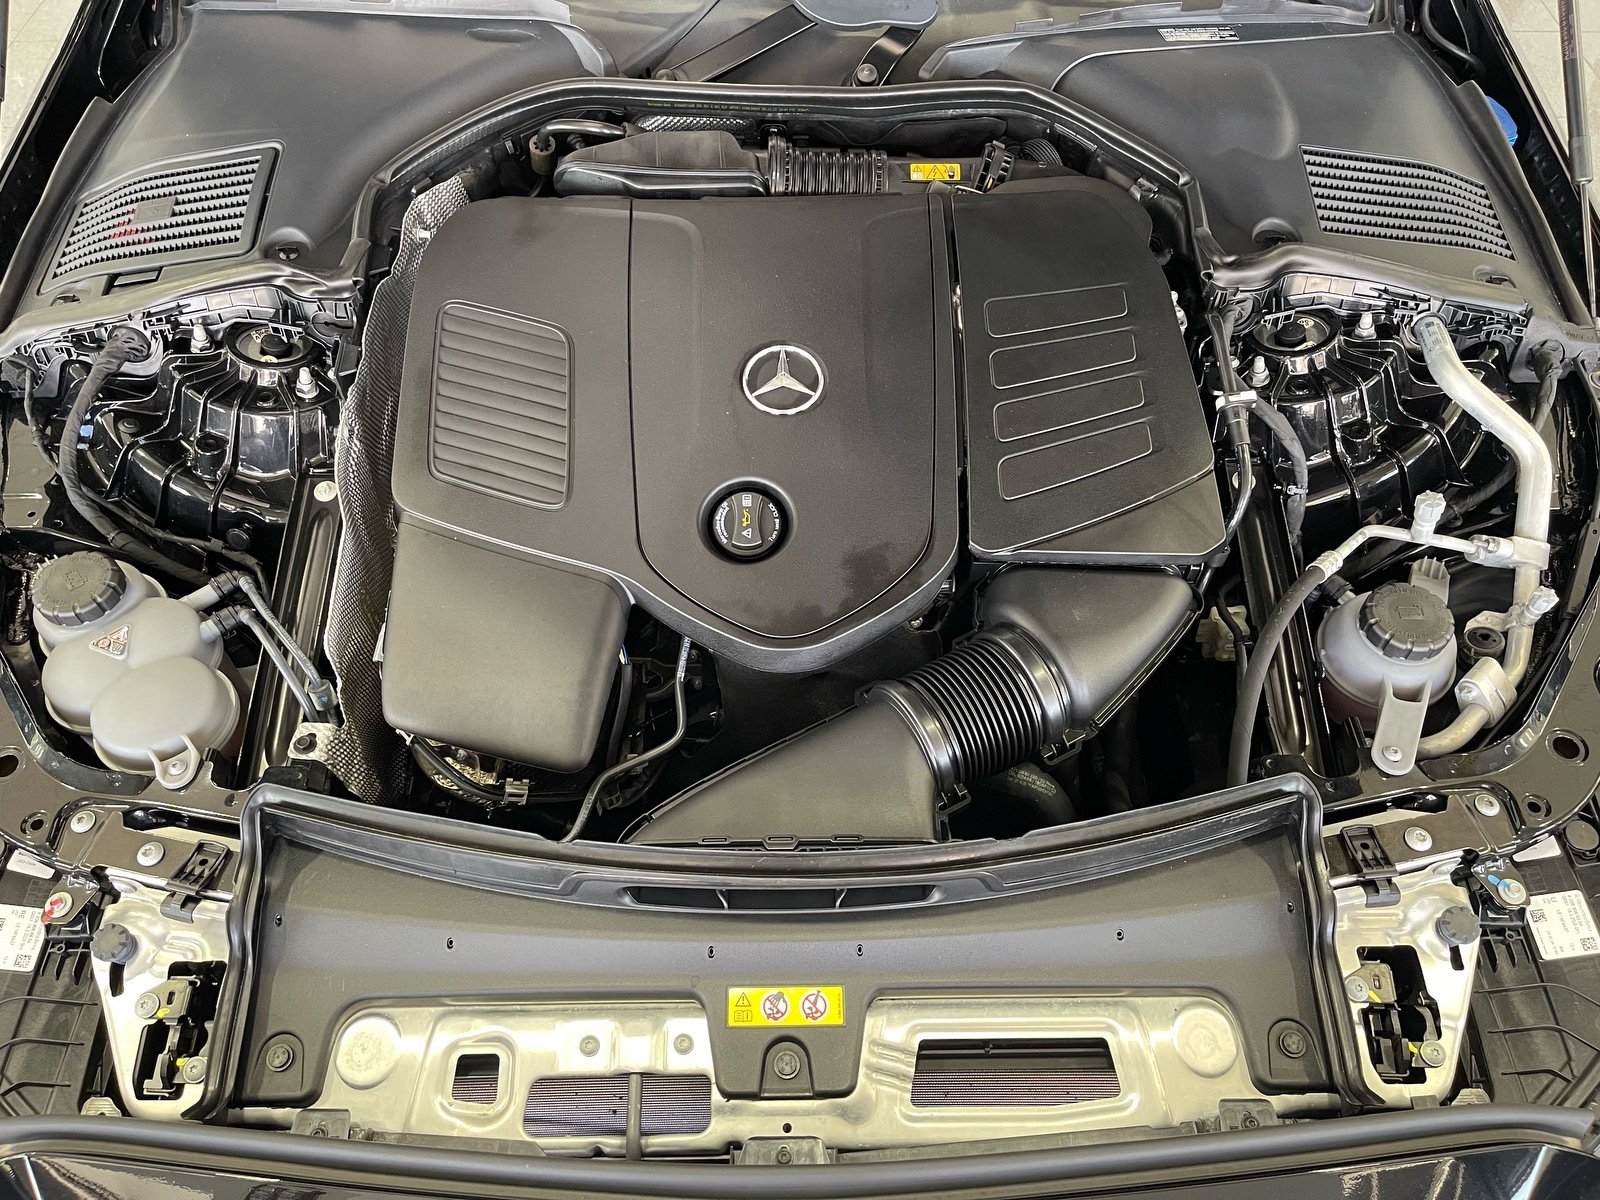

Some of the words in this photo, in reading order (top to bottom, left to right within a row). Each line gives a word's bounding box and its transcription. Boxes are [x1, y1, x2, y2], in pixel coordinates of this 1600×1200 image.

[768, 502, 779, 517] CLICK
[715, 507, 728, 544] Mercedes-Benz
[768, 531, 778, 542] Turn
